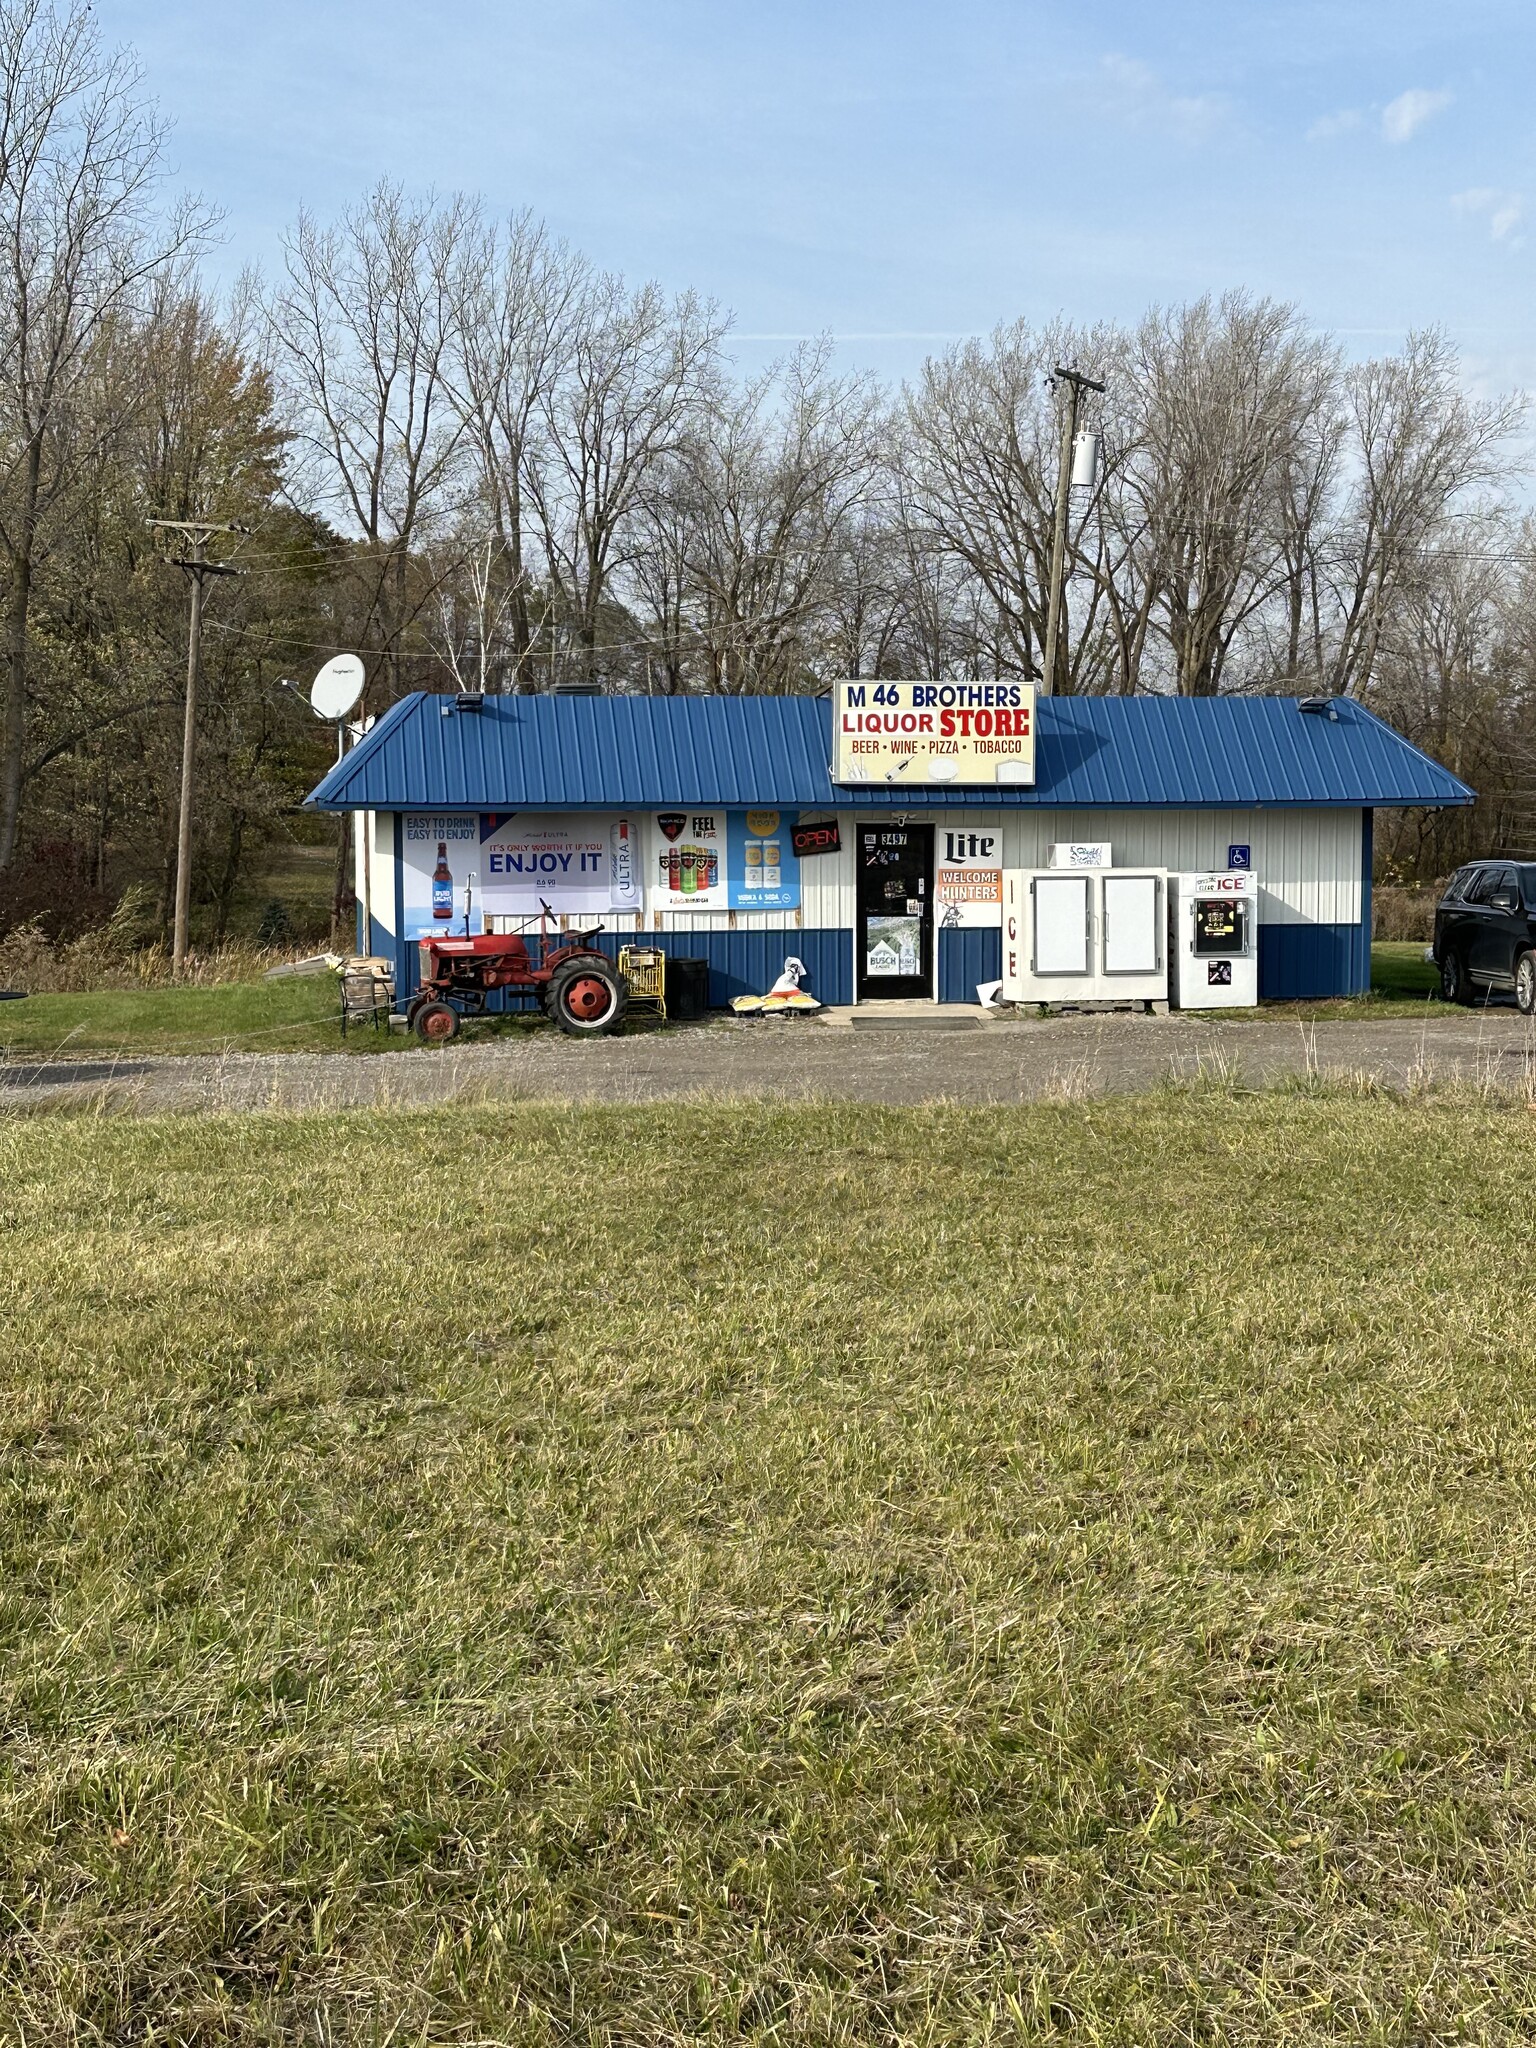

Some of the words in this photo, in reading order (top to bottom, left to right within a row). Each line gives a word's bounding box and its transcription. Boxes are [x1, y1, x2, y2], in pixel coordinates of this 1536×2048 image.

[848, 686, 866, 707] M
[873, 685, 899, 706] 46
[913, 685, 1021, 707] BROTHERS
[843, 713, 934, 733] LIQUOR
[940, 709, 1030, 737] STORE
[852, 741, 879, 754] BEER
[891, 741, 918, 754] WINE
[929, 741, 959, 754] PIZZA
[973, 740, 1022, 754] TOBACCO
[407, 818, 431, 828] EASY
[433, 818, 445, 828] TO
[447, 818, 475, 828] DRINK
[692, 817, 716, 830] FEEL
[407, 829, 431, 840] EASY
[433, 829, 444, 839] TO
[447, 829, 475, 839] ENJOY
[795, 828, 838, 848] OPEN
[490, 844, 504, 852] IT'S
[507, 844, 530, 852] ONLY
[585, 843, 603, 851] YOU
[944, 832, 995, 865] Lite
[490, 853, 573, 873] ENJOY
[581, 853, 602, 872] IT
[619, 844, 630, 890] ULTRA
[942, 872, 998, 883] WELCOME
[1217, 877, 1246, 890] ICE
[941, 886, 998, 899] HUNTERS
[1008, 880, 1016, 977] ICE
[870, 957, 896, 965] BUSCH
